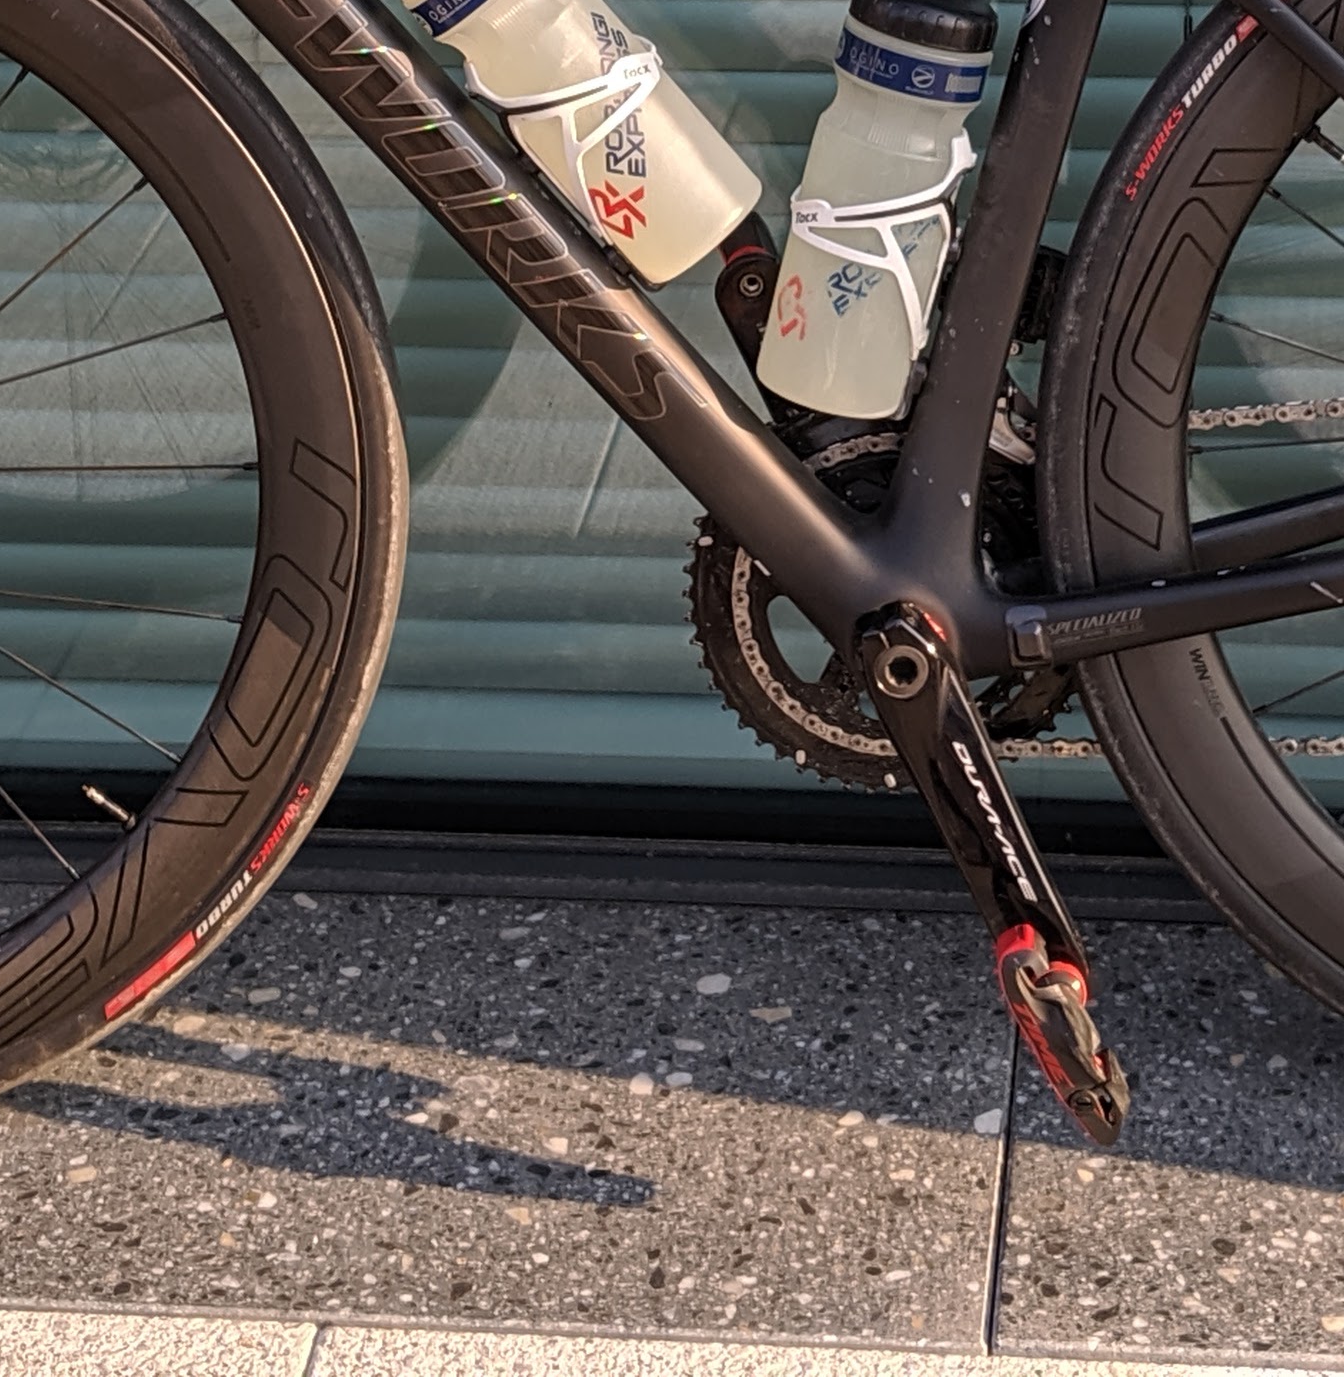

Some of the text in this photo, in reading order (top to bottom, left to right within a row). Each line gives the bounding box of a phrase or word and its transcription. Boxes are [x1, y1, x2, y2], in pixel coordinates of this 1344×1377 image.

[849, 47, 900, 76] OGINO
[1124, 34, 1238, 201] S-WORKS TURBO
[1046, 606, 1143, 635] SPECIALIZED
[195, 782, 311, 941] S-WORKS TURBO
